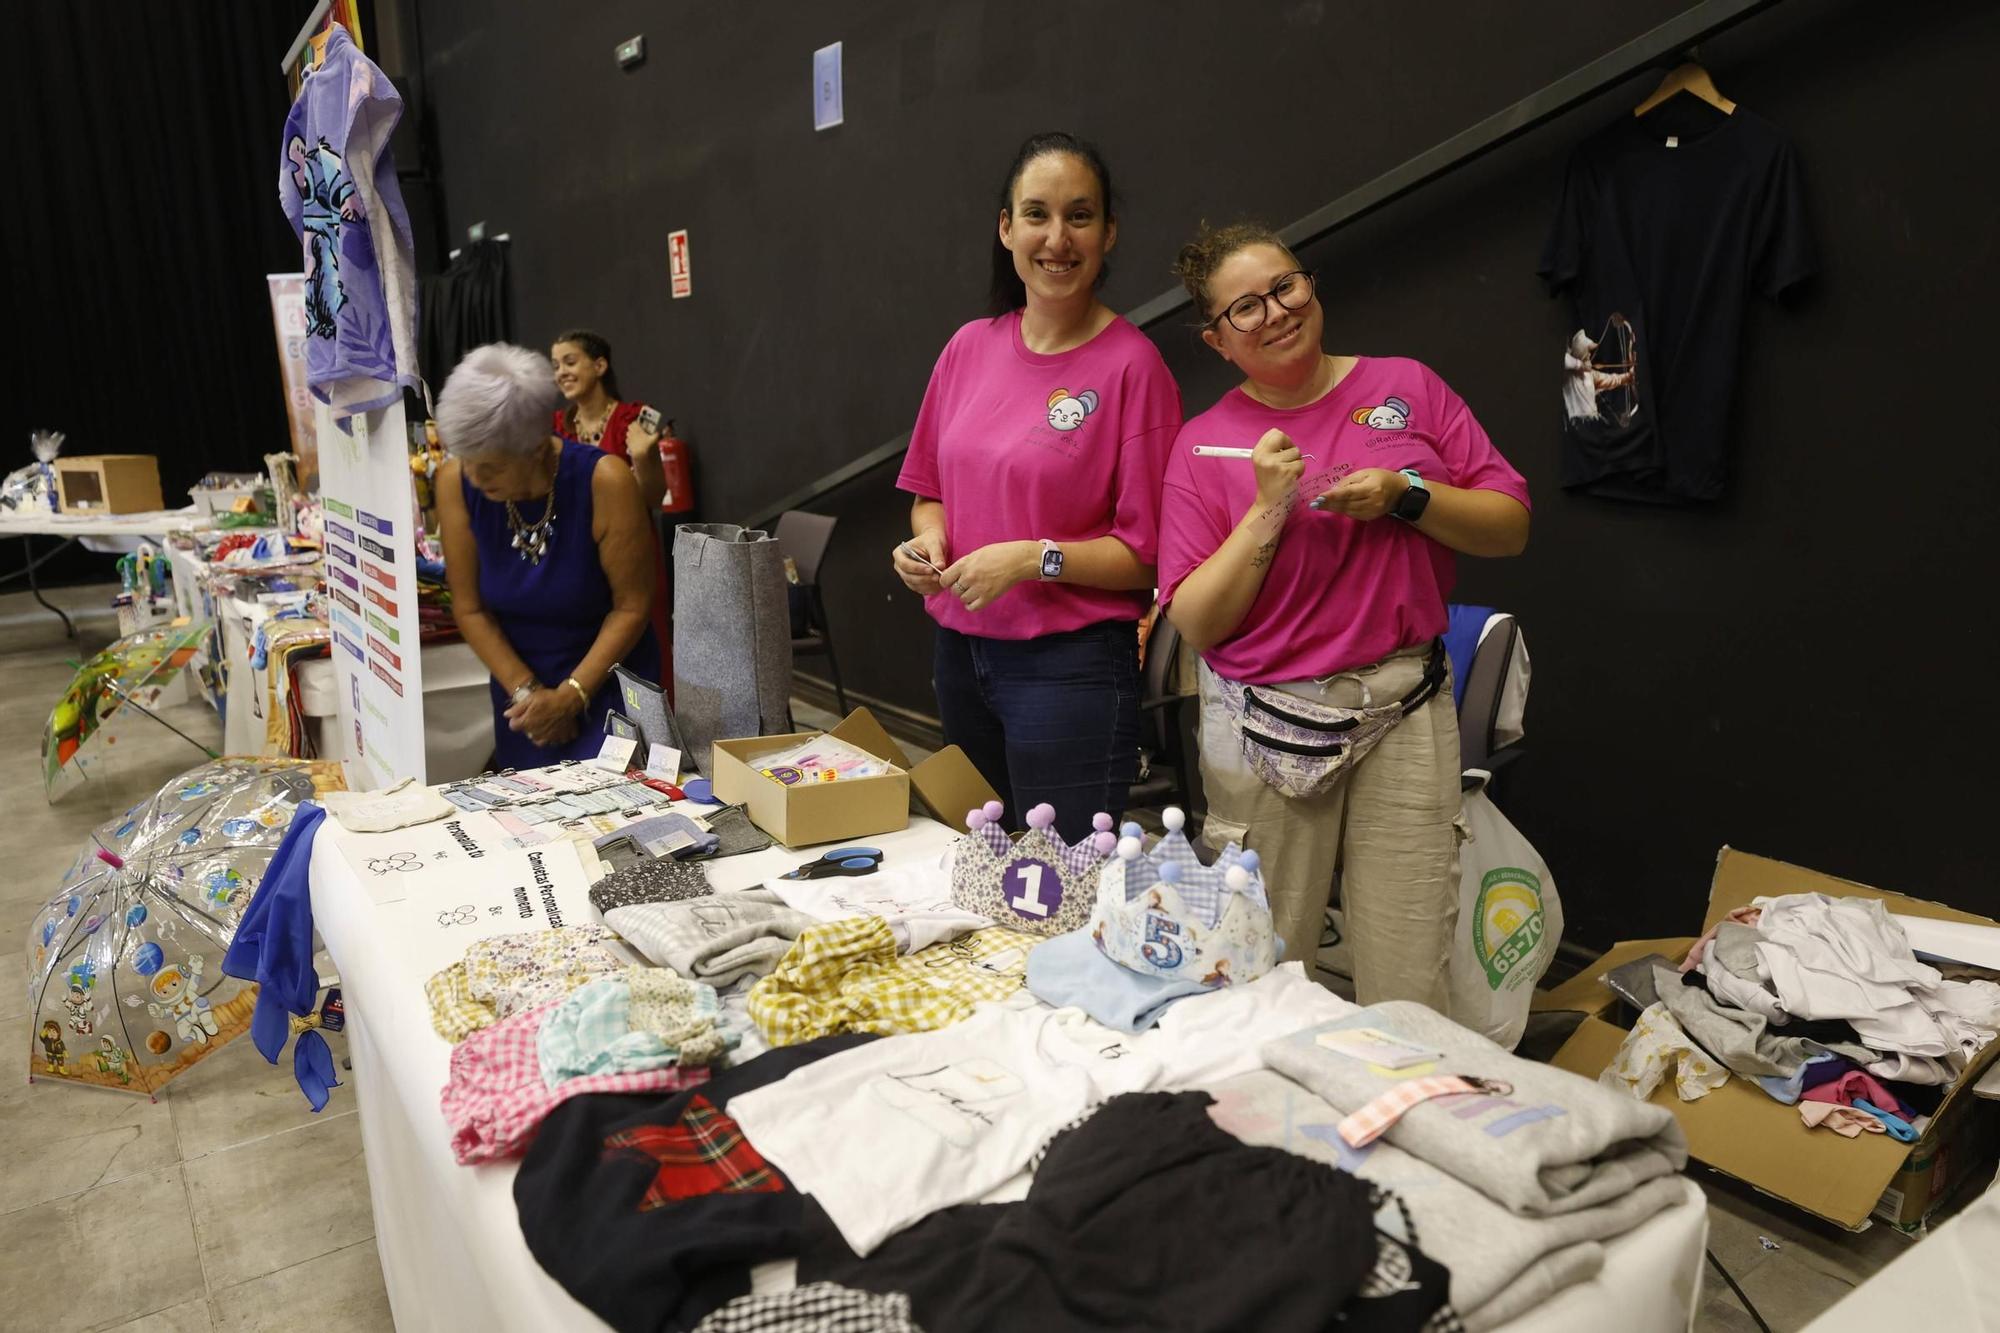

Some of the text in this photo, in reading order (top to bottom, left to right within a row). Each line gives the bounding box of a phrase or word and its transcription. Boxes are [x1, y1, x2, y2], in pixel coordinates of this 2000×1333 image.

[443, 820, 486, 858] Personaliza tu
[528, 852, 550, 885] Camisetas
[513, 886, 535, 919] momento
[1012, 864, 1048, 918] 1
[1141, 914, 1183, 969] 5
